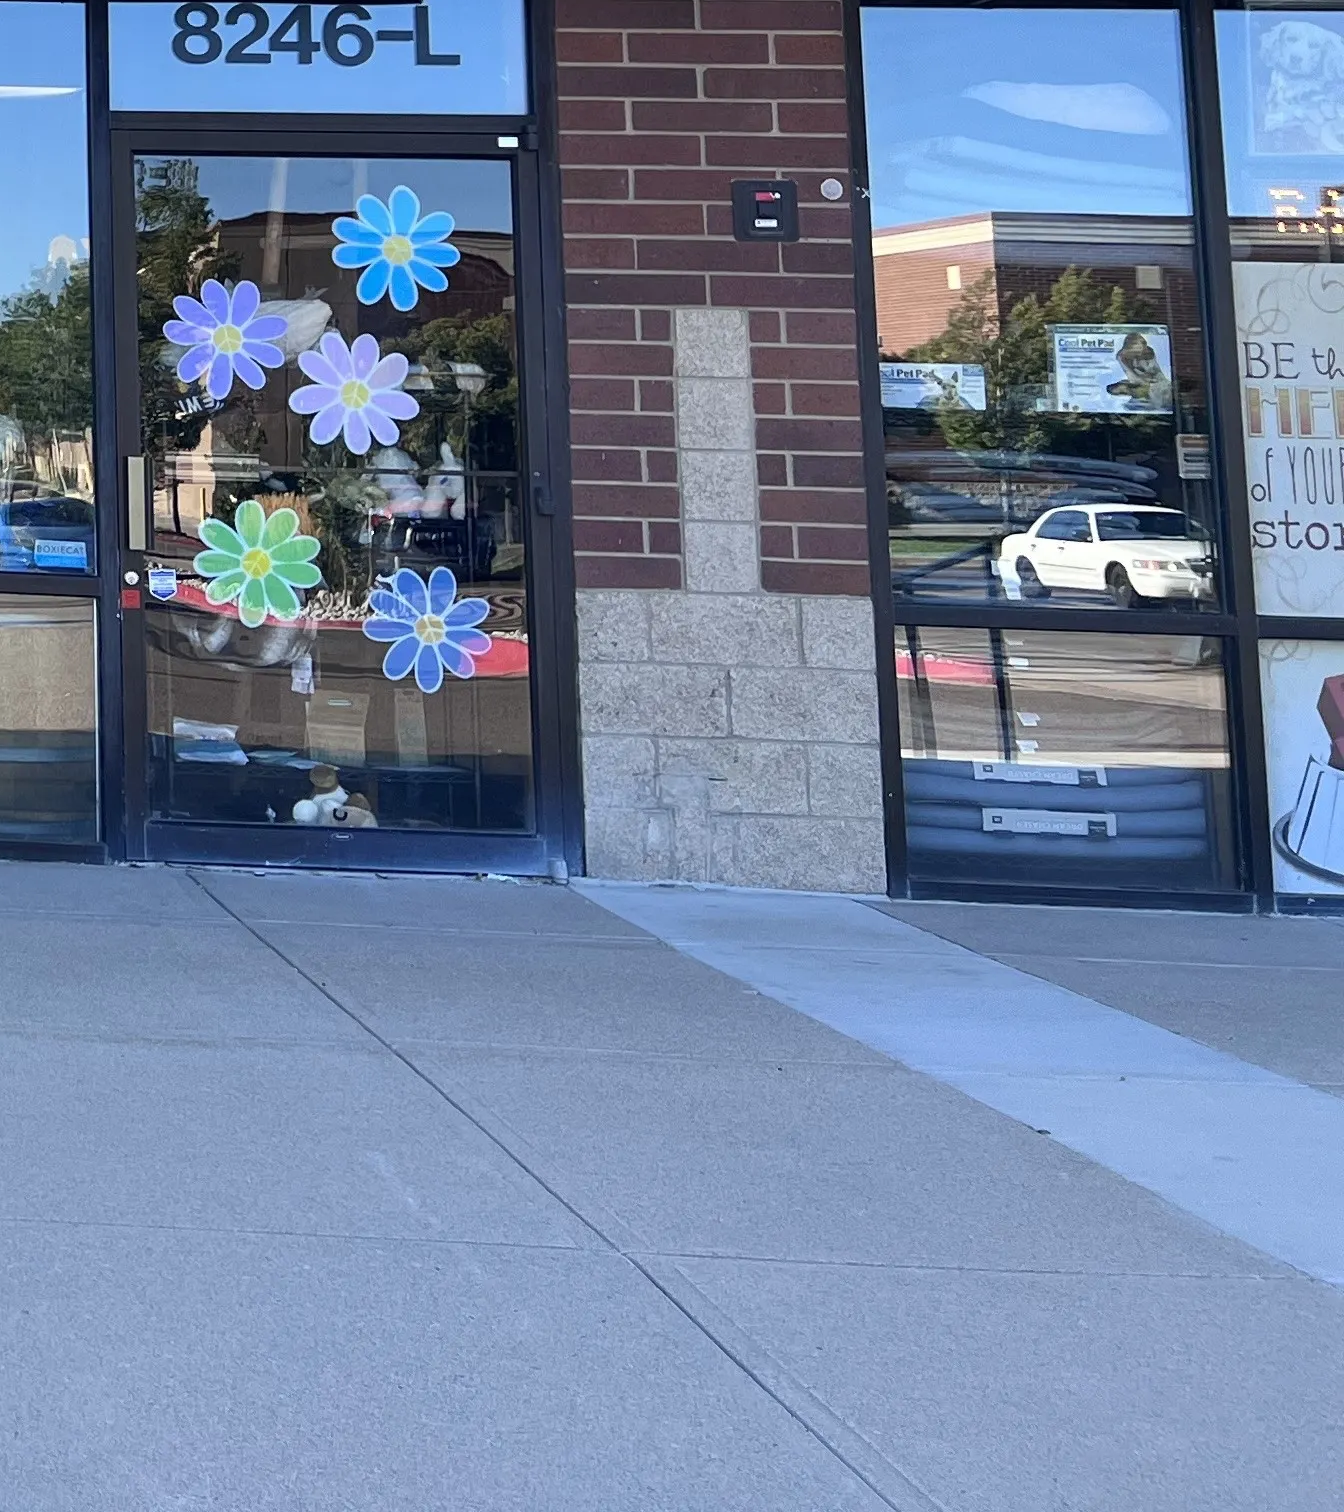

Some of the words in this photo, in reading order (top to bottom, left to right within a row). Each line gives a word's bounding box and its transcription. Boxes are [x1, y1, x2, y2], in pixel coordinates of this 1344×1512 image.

[172, 2, 461, 67] 8246-L
[1243, 341, 1300, 379] BE
[1251, 447, 1274, 503] of
